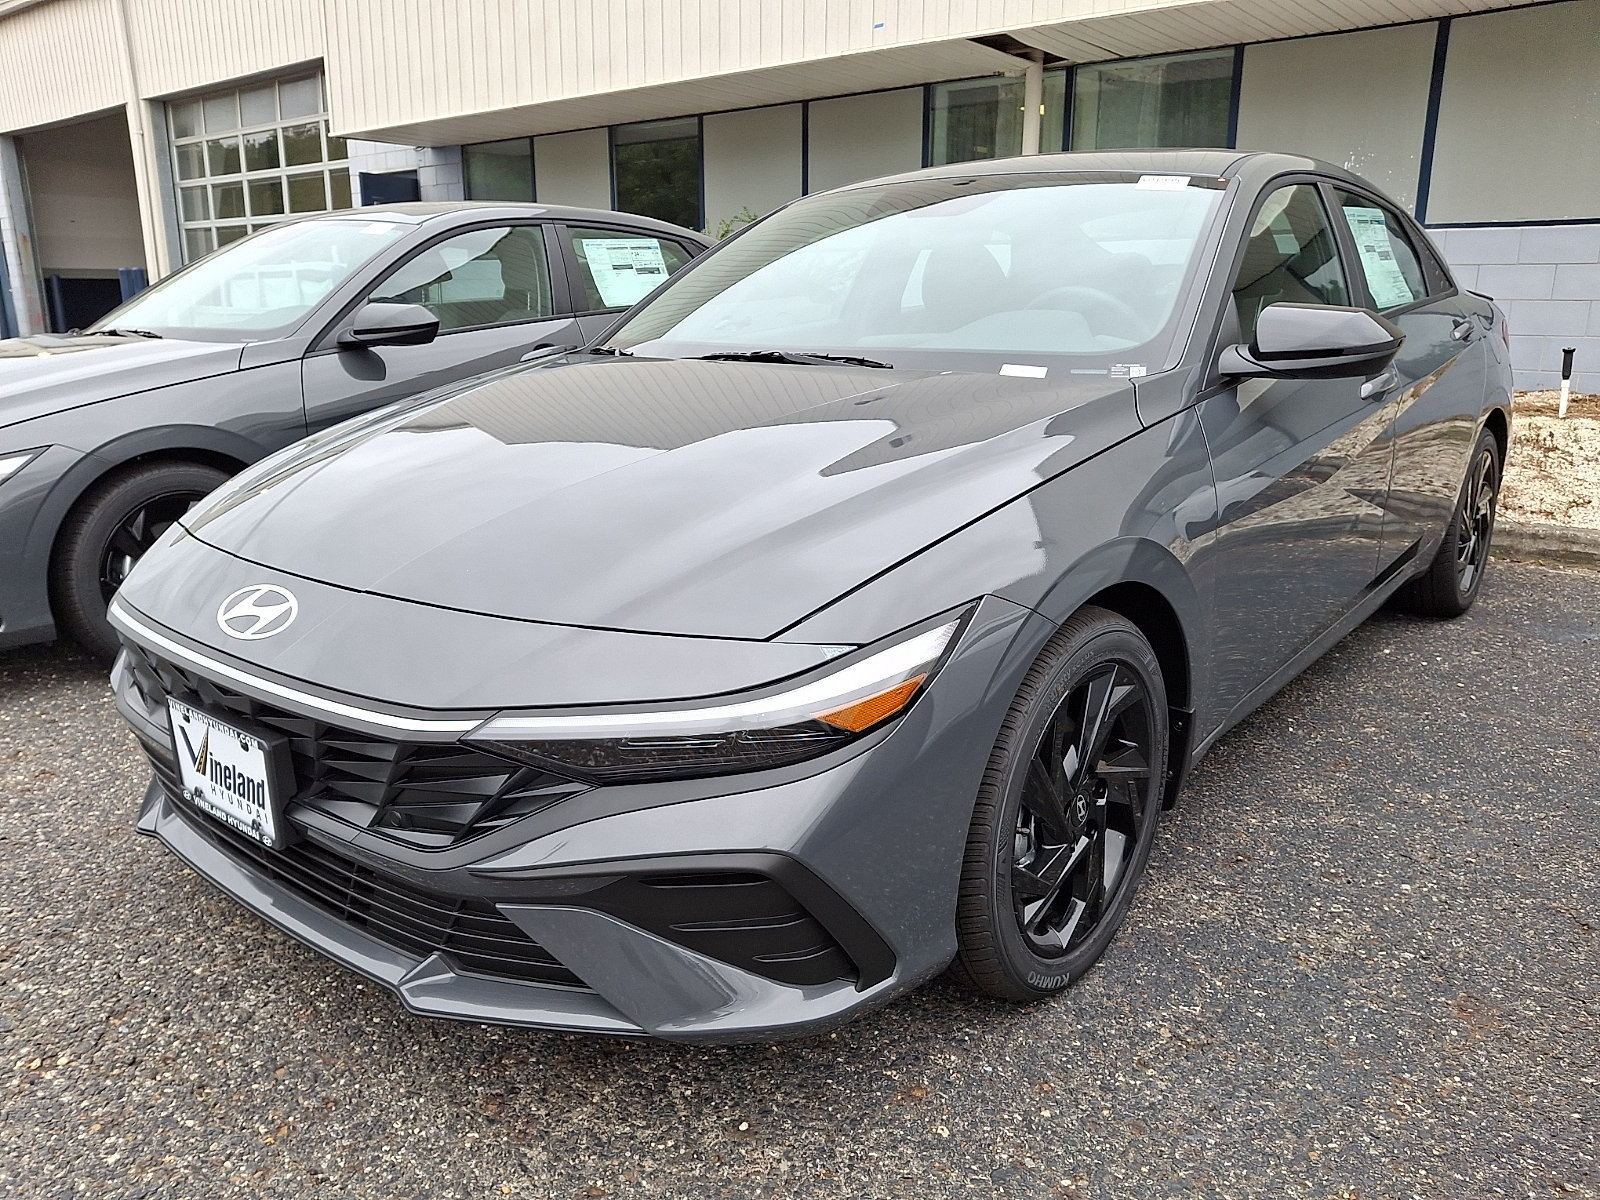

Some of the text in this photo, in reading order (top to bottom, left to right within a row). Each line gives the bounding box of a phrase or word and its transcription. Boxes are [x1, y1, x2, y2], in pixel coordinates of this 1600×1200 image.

[178, 724, 266, 810] Vineland
[193, 794, 260, 841] VINELAND HYUNDAI
[210, 783, 269, 825] HYUNDAI
[1027, 970, 1071, 989] KUMHO
